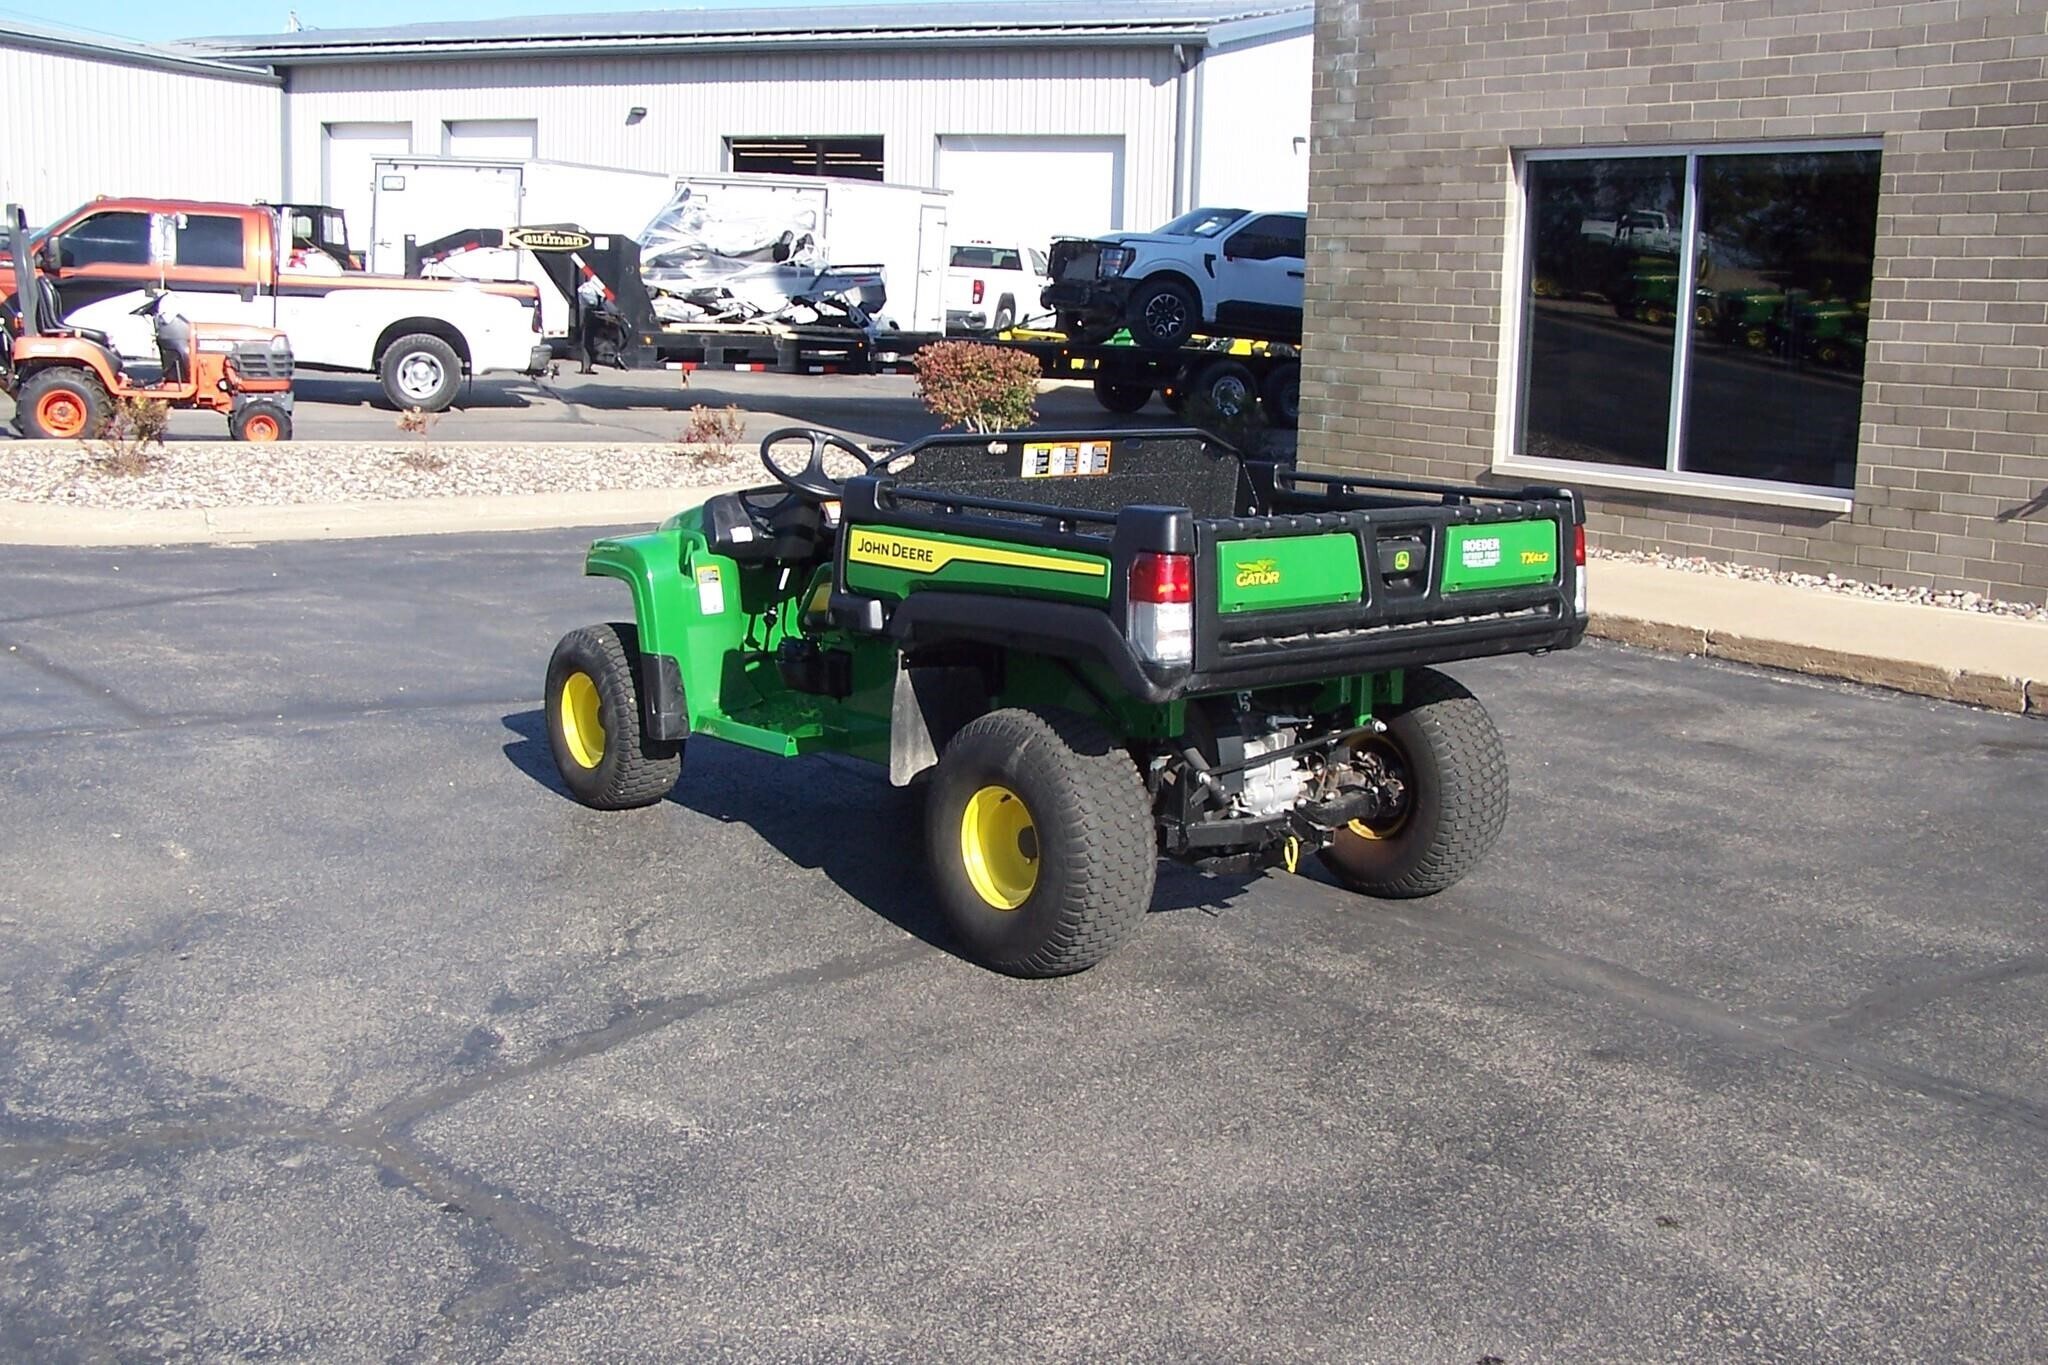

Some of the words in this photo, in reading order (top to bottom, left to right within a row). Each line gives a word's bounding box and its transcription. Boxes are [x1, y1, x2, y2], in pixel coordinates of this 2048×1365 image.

[499, 228, 584, 250] Kaufman
[857, 538, 890, 556] JOHN
[892, 543, 934, 563] DEERE
[1235, 568, 1281, 587] GATOR
